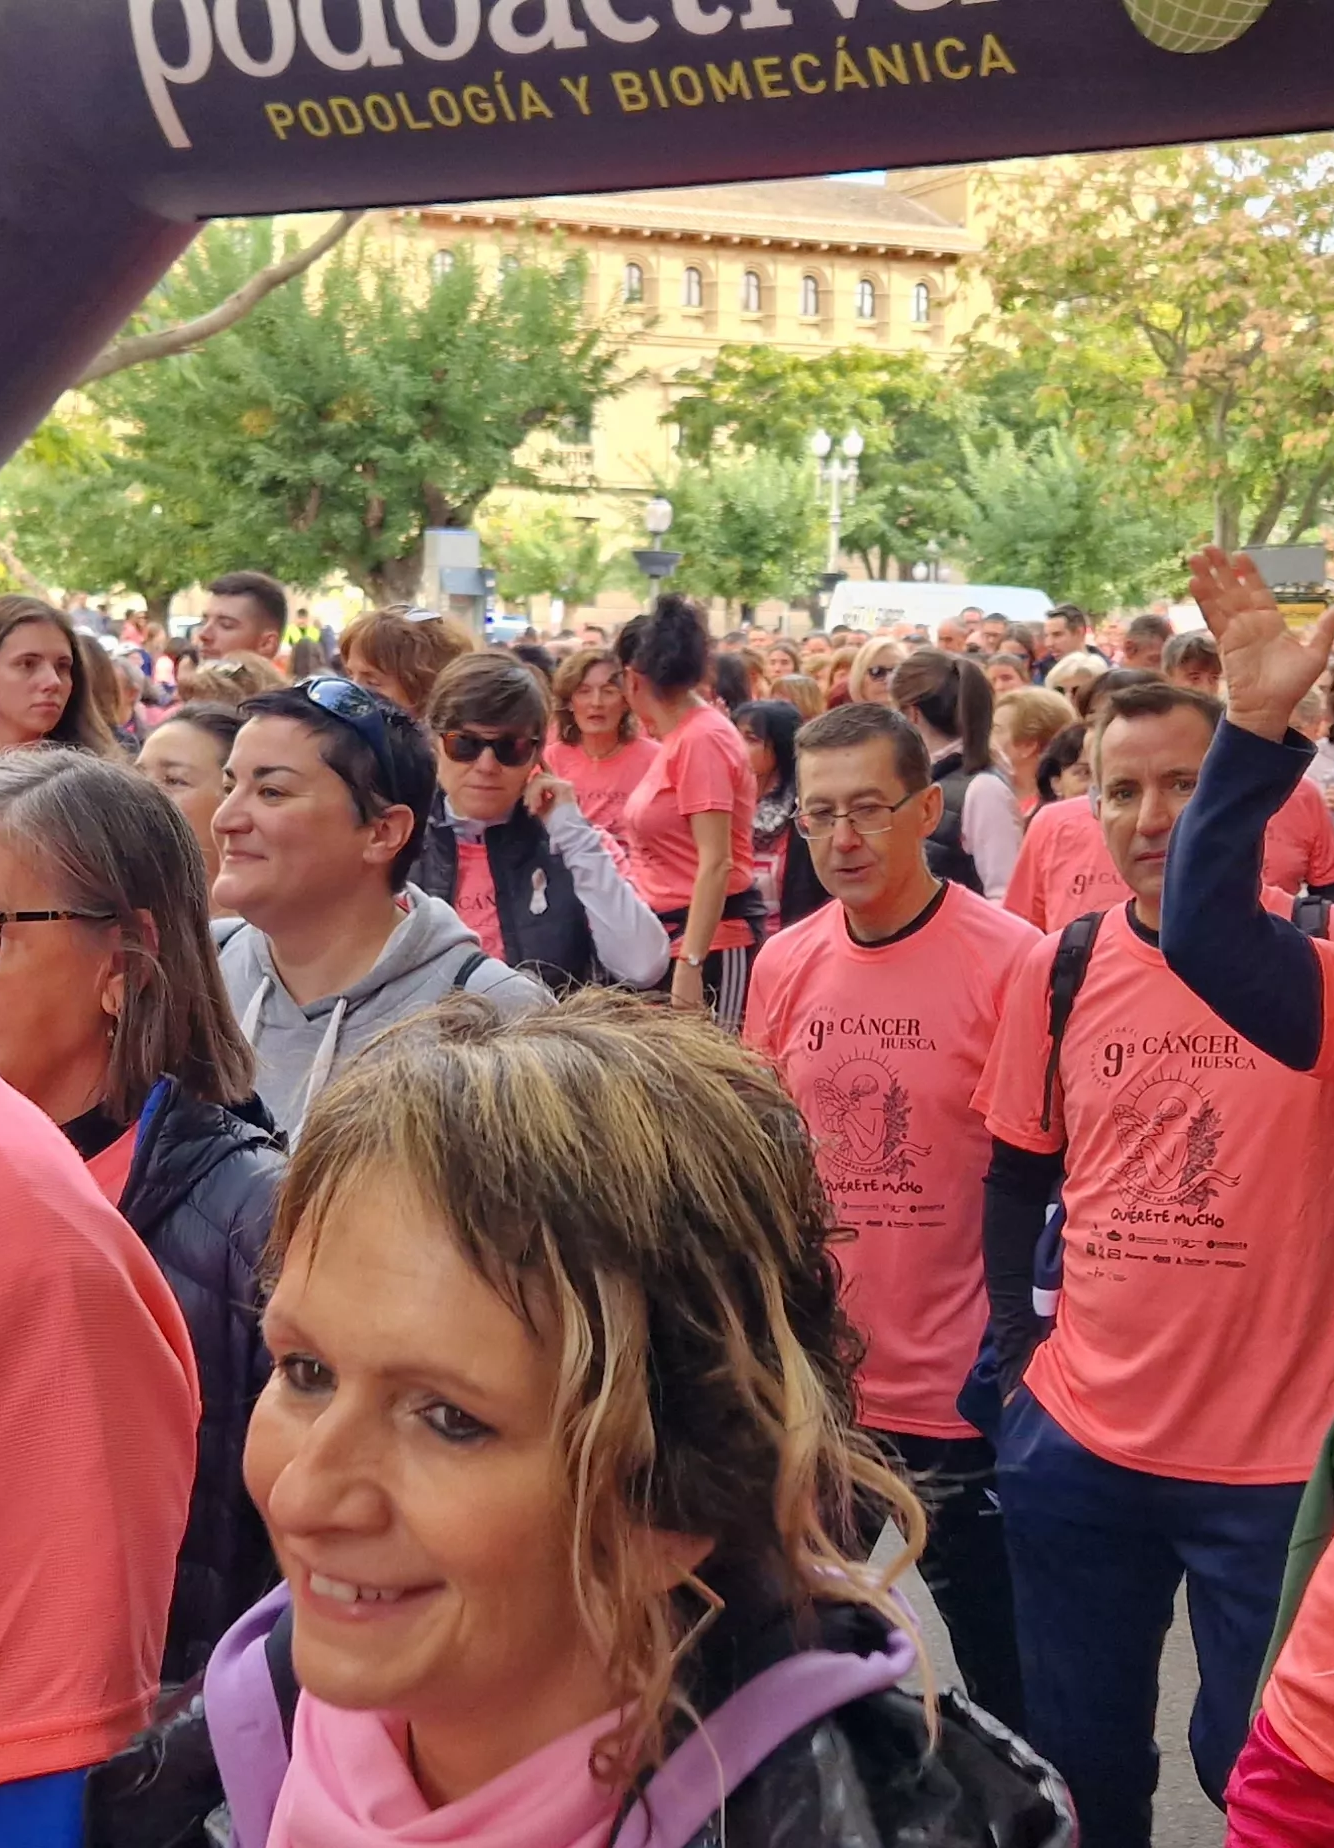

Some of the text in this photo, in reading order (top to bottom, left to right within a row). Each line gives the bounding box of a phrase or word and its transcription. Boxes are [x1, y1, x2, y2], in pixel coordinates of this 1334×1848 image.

[265, 33, 1017, 141] PODOLOGÍA Y BIOMECÁNICA
[807, 1014, 921, 1052] 9ª CÁNCER
[880, 1037, 937, 1051] HUESCA
[1102, 1042, 1135, 1078] 9ª
[1142, 1031, 1240, 1055] CÁNCER
[1190, 1056, 1257, 1070] HUESCA
[882, 1180, 923, 1195] MUCHO
[1173, 1212, 1225, 1229] MUCHO
